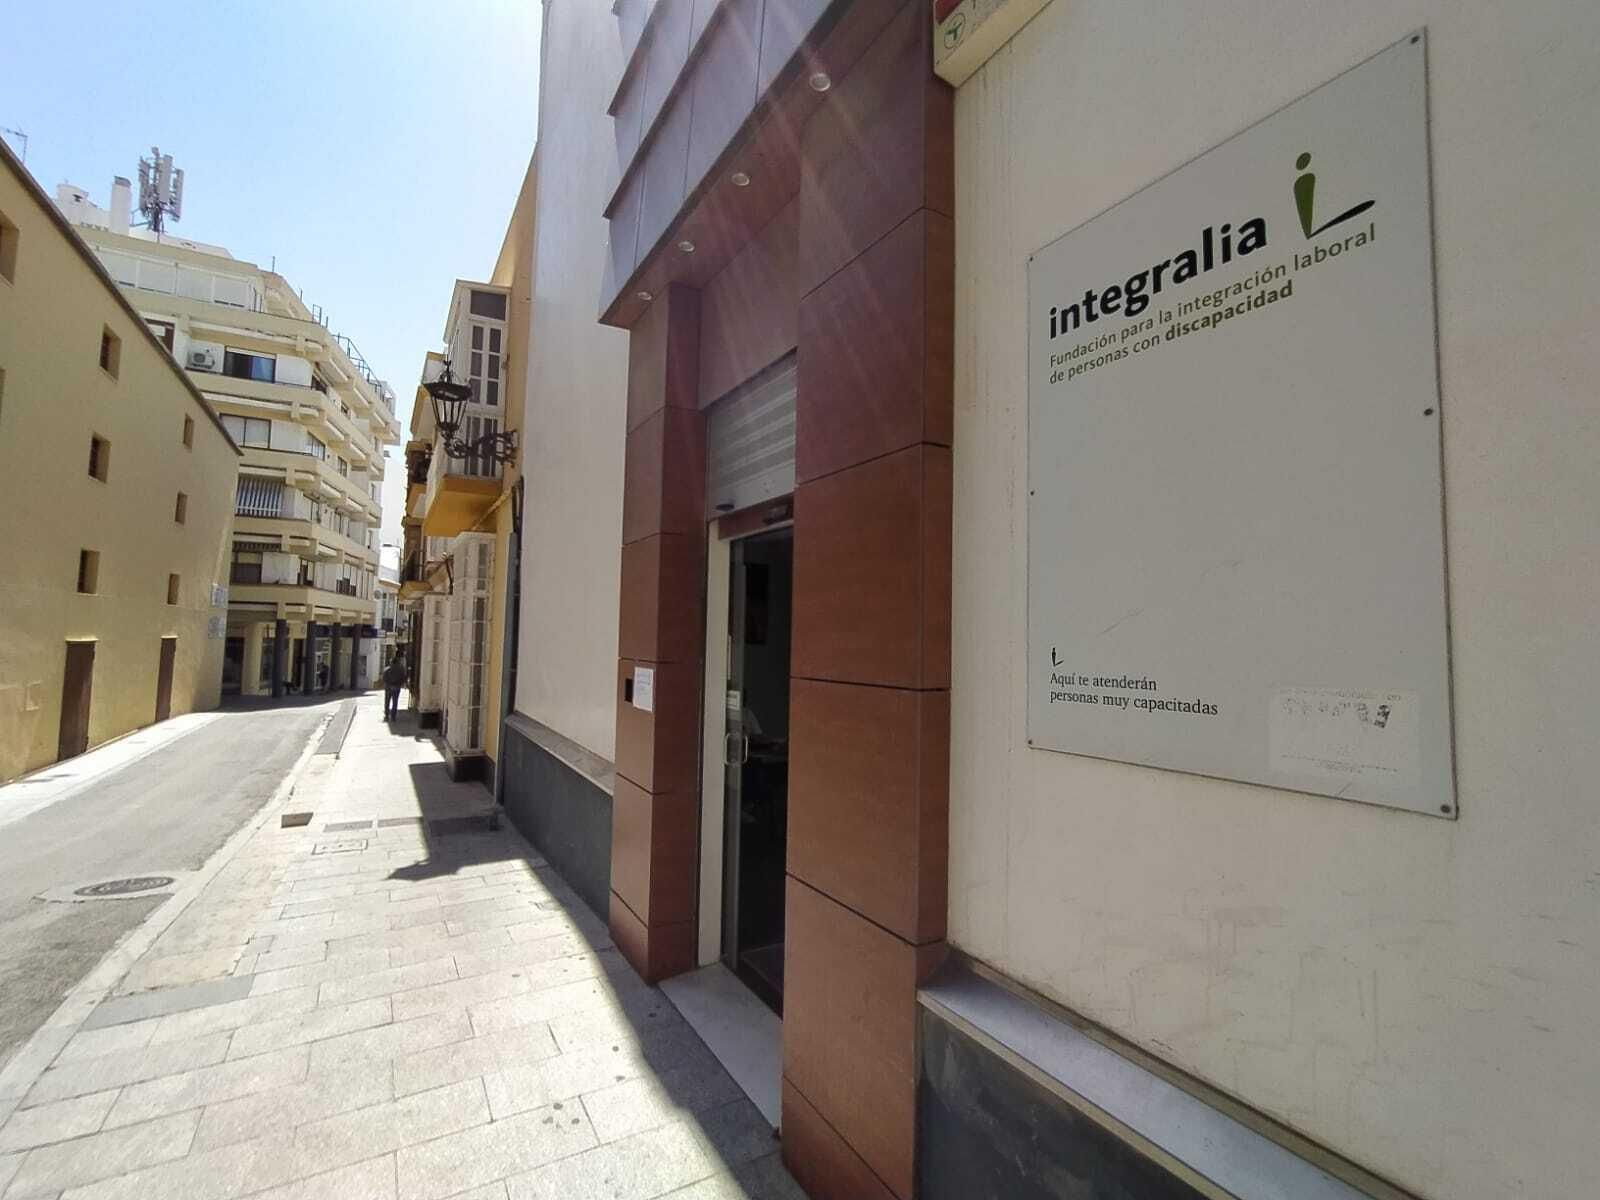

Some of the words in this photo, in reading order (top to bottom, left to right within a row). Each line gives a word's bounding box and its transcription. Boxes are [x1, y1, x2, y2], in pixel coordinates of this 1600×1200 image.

[1050, 217, 1267, 339] integralia
[1050, 333, 1116, 368] Fundación
[1121, 318, 1153, 343] para
[1159, 310, 1172, 324] la
[1178, 264, 1287, 318] integración
[1294, 222, 1375, 271] laboral
[1049, 370, 1064, 384] de
[1068, 346, 1129, 380] personas
[1133, 335, 1160, 353] con
[1165, 279, 1293, 341] discapacidad
[1050, 672, 1075, 687] Aquí
[1078, 675, 1089, 686] te
[1093, 675, 1157, 691] atenderán
[1050, 690, 1098, 704] personas
[1103, 695, 1129, 710] muy
[1134, 698, 1218, 715] capacitadas
